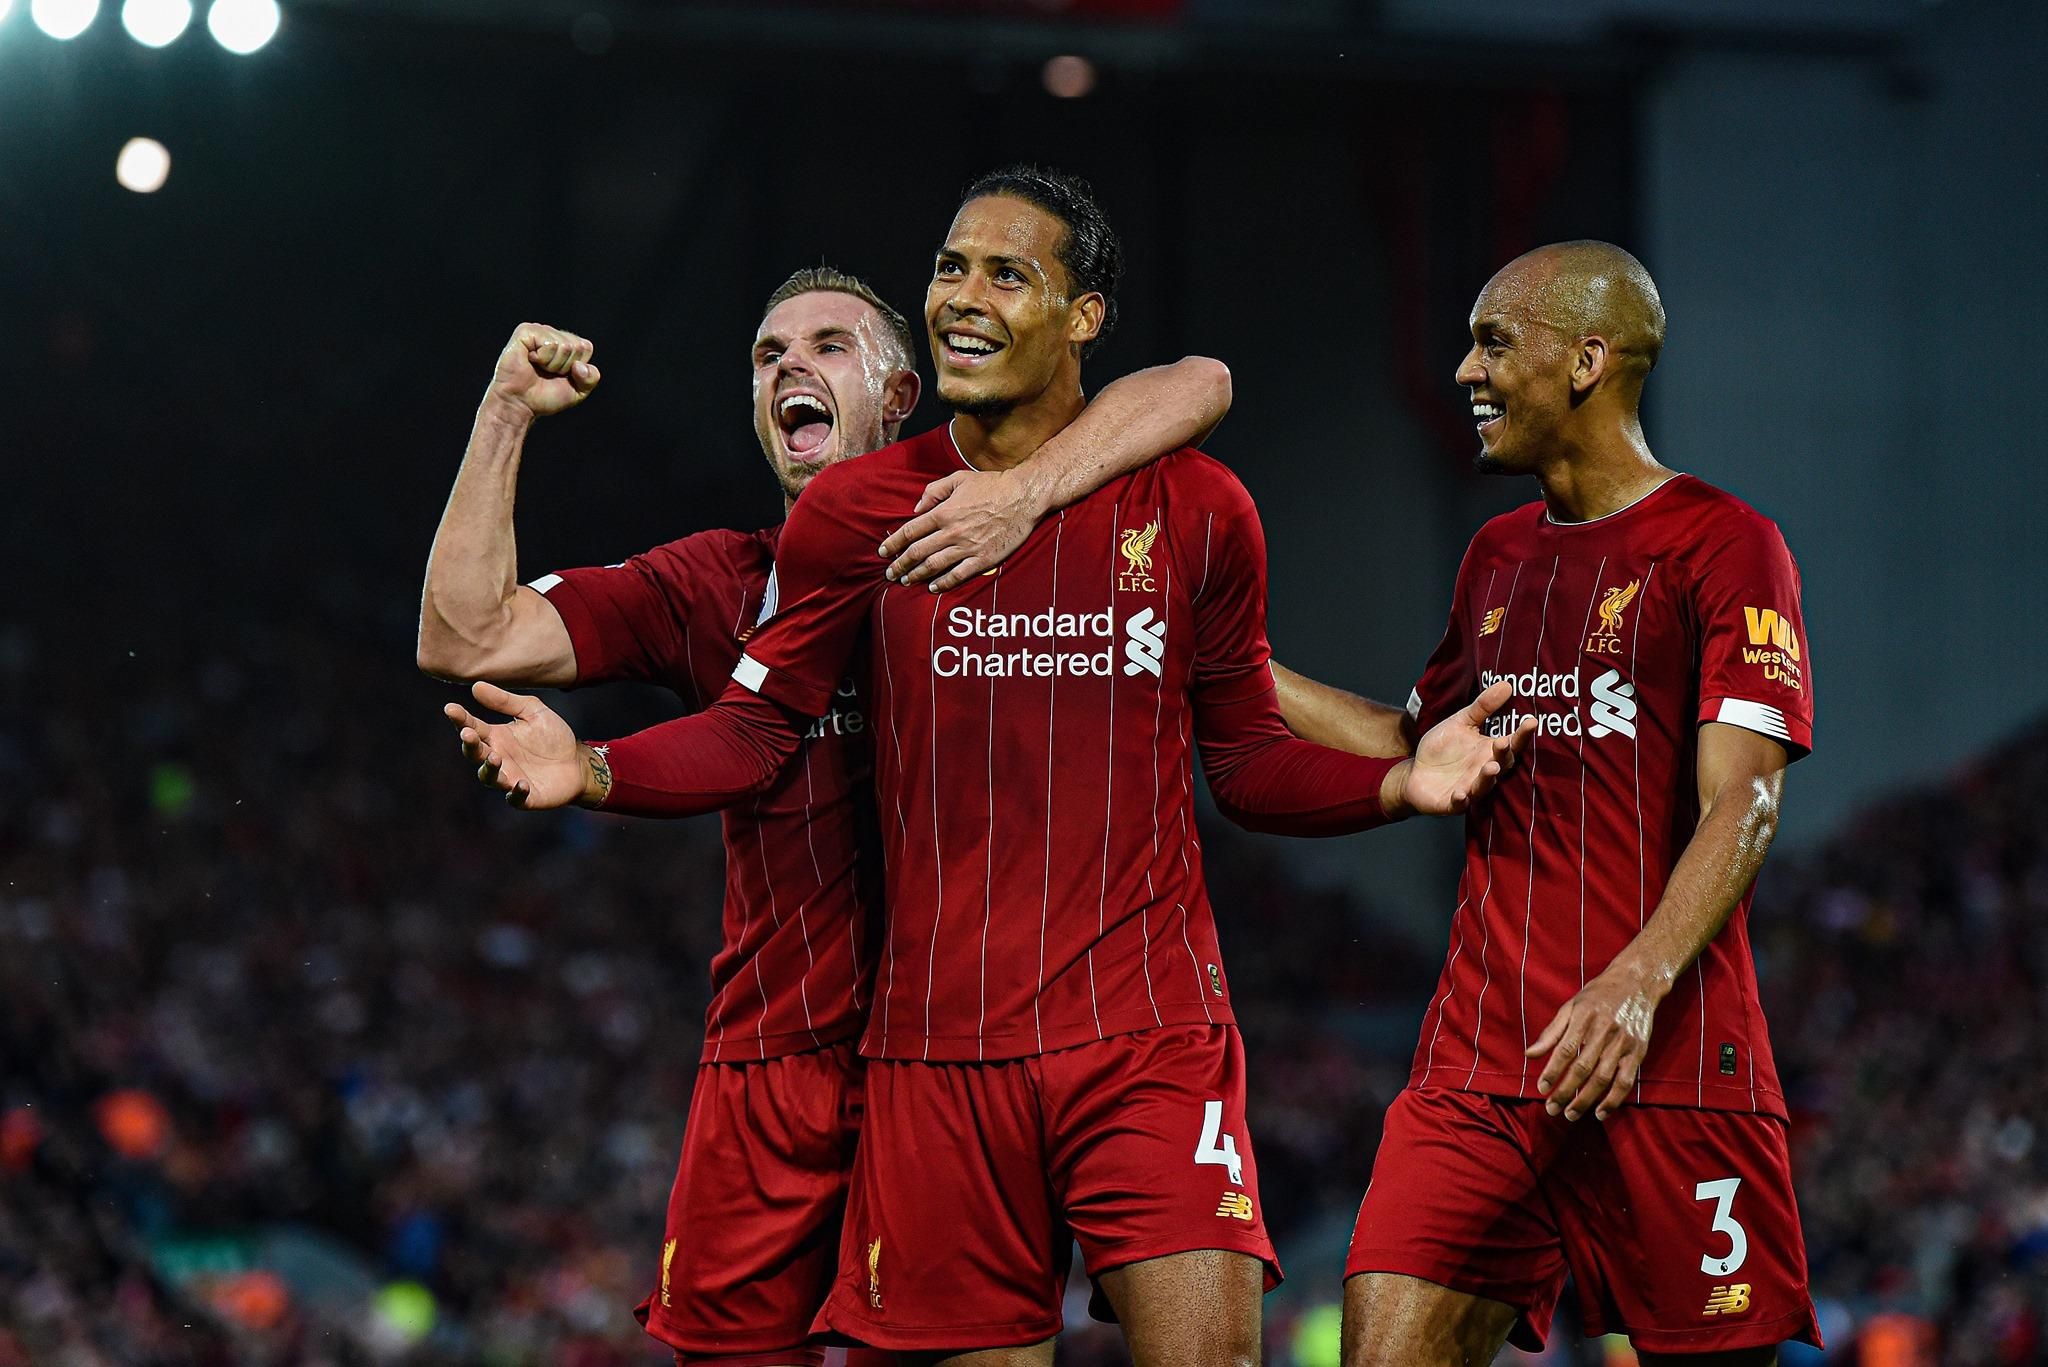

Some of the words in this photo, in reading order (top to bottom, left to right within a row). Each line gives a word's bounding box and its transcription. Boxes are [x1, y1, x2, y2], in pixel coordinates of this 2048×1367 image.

[1118, 577, 1158, 592] L.F.C.
[947, 606, 1114, 638] Standard
[1743, 606, 1800, 662] WU
[933, 645, 1114, 678] Chartered
[1586, 638, 1623, 654] L.F.C.
[1764, 665, 1803, 698] Unio
[1194, 1100, 1244, 1187] 4
[1695, 1177, 1747, 1276] 3
